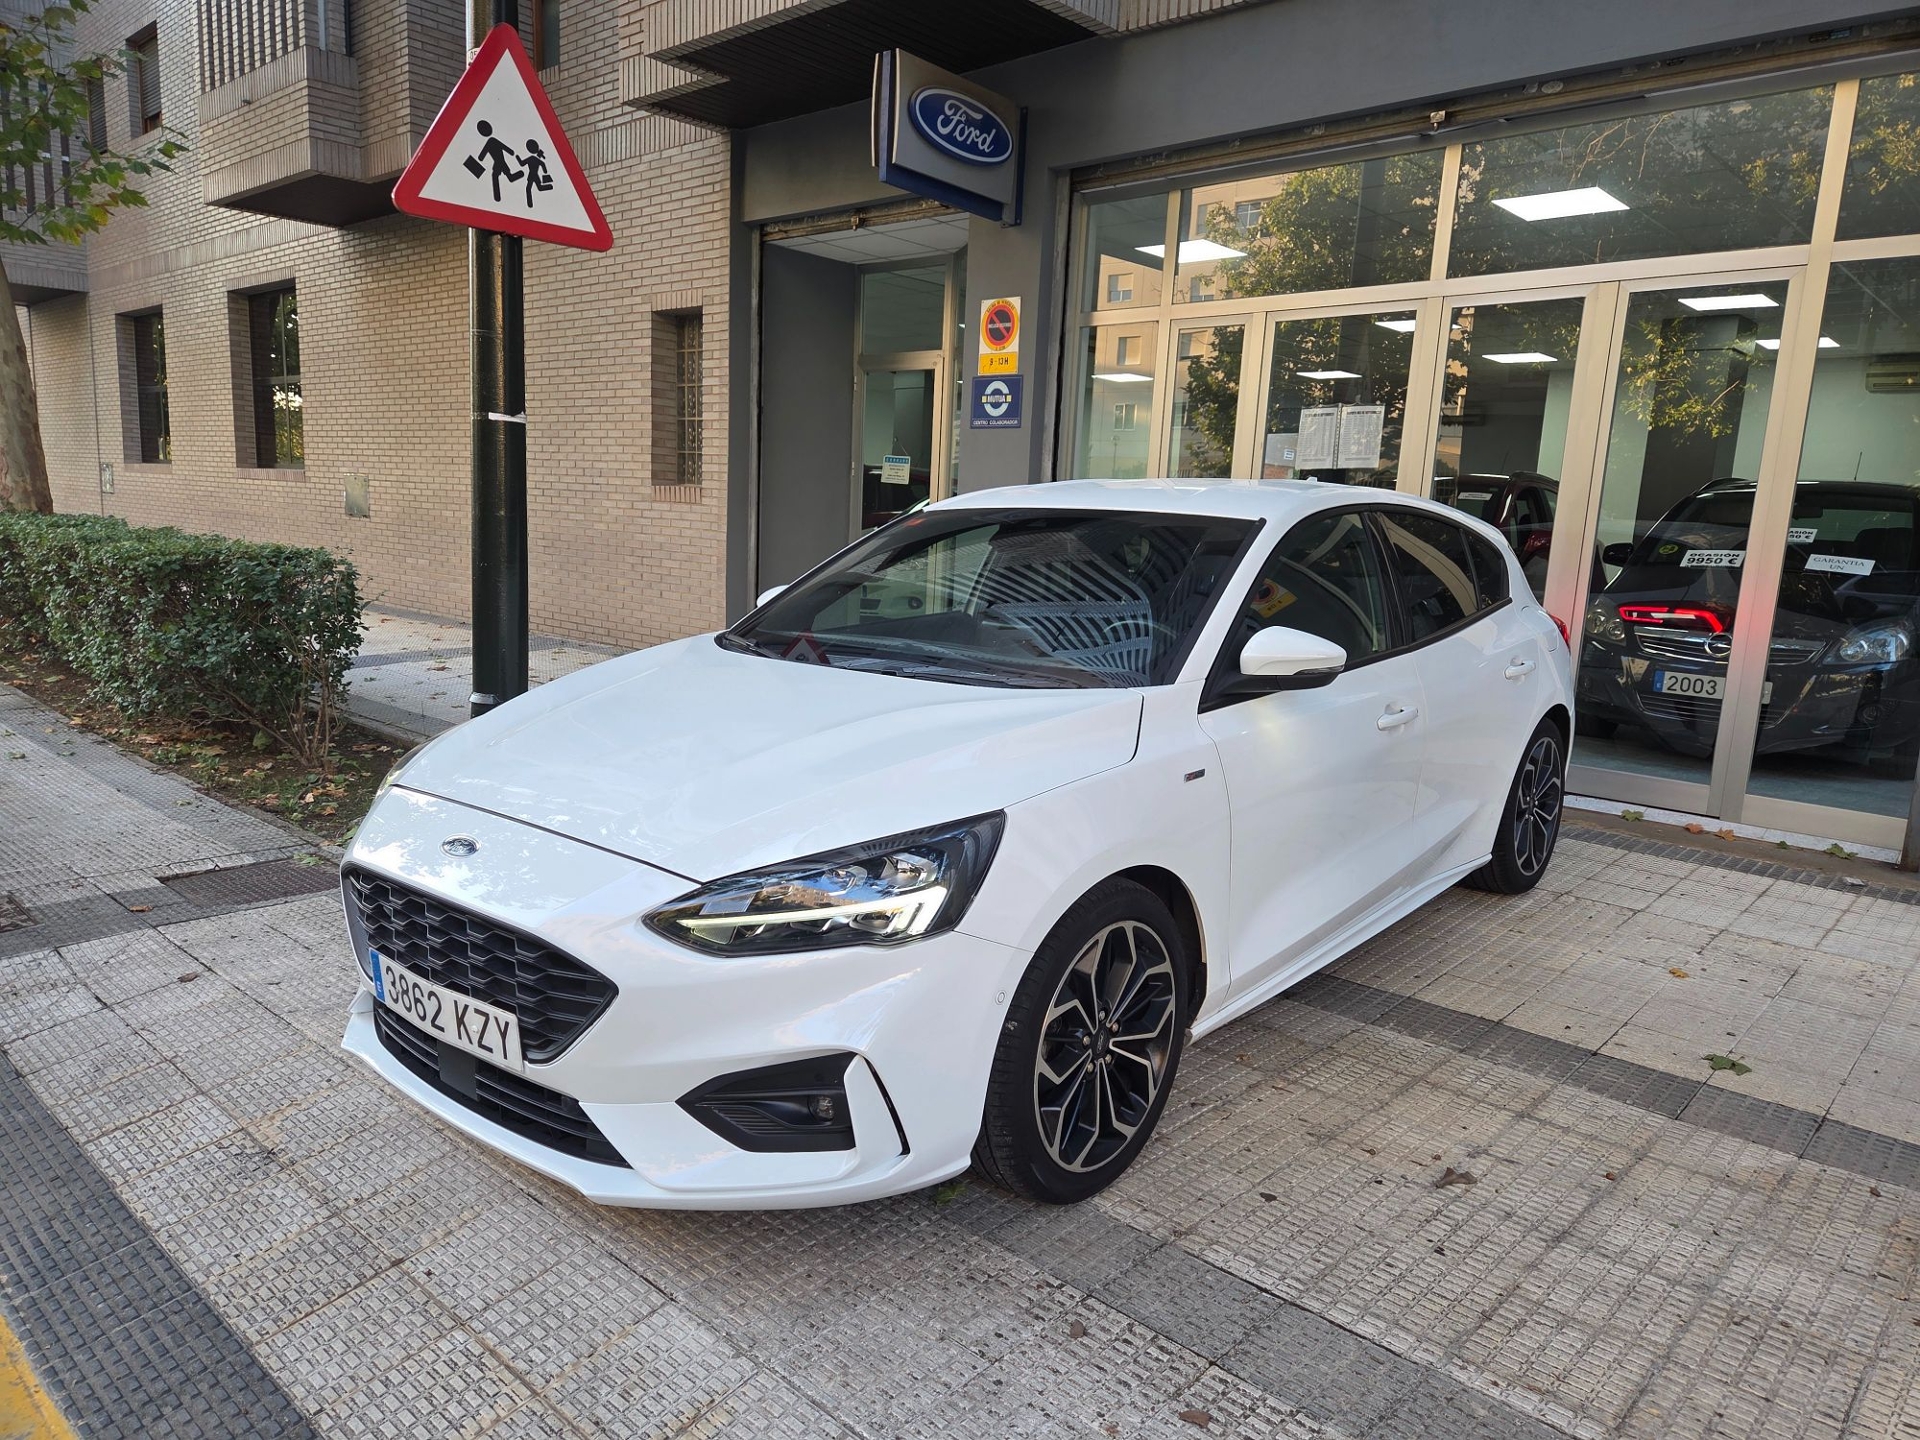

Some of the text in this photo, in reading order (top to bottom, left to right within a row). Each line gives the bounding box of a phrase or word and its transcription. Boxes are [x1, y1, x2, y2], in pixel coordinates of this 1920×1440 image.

[937, 100, 996, 153] Ford
[1667, 675, 1718, 695] 2003
[376, 981, 382, 993] E
[386, 965, 510, 1060] 3862 KZY
